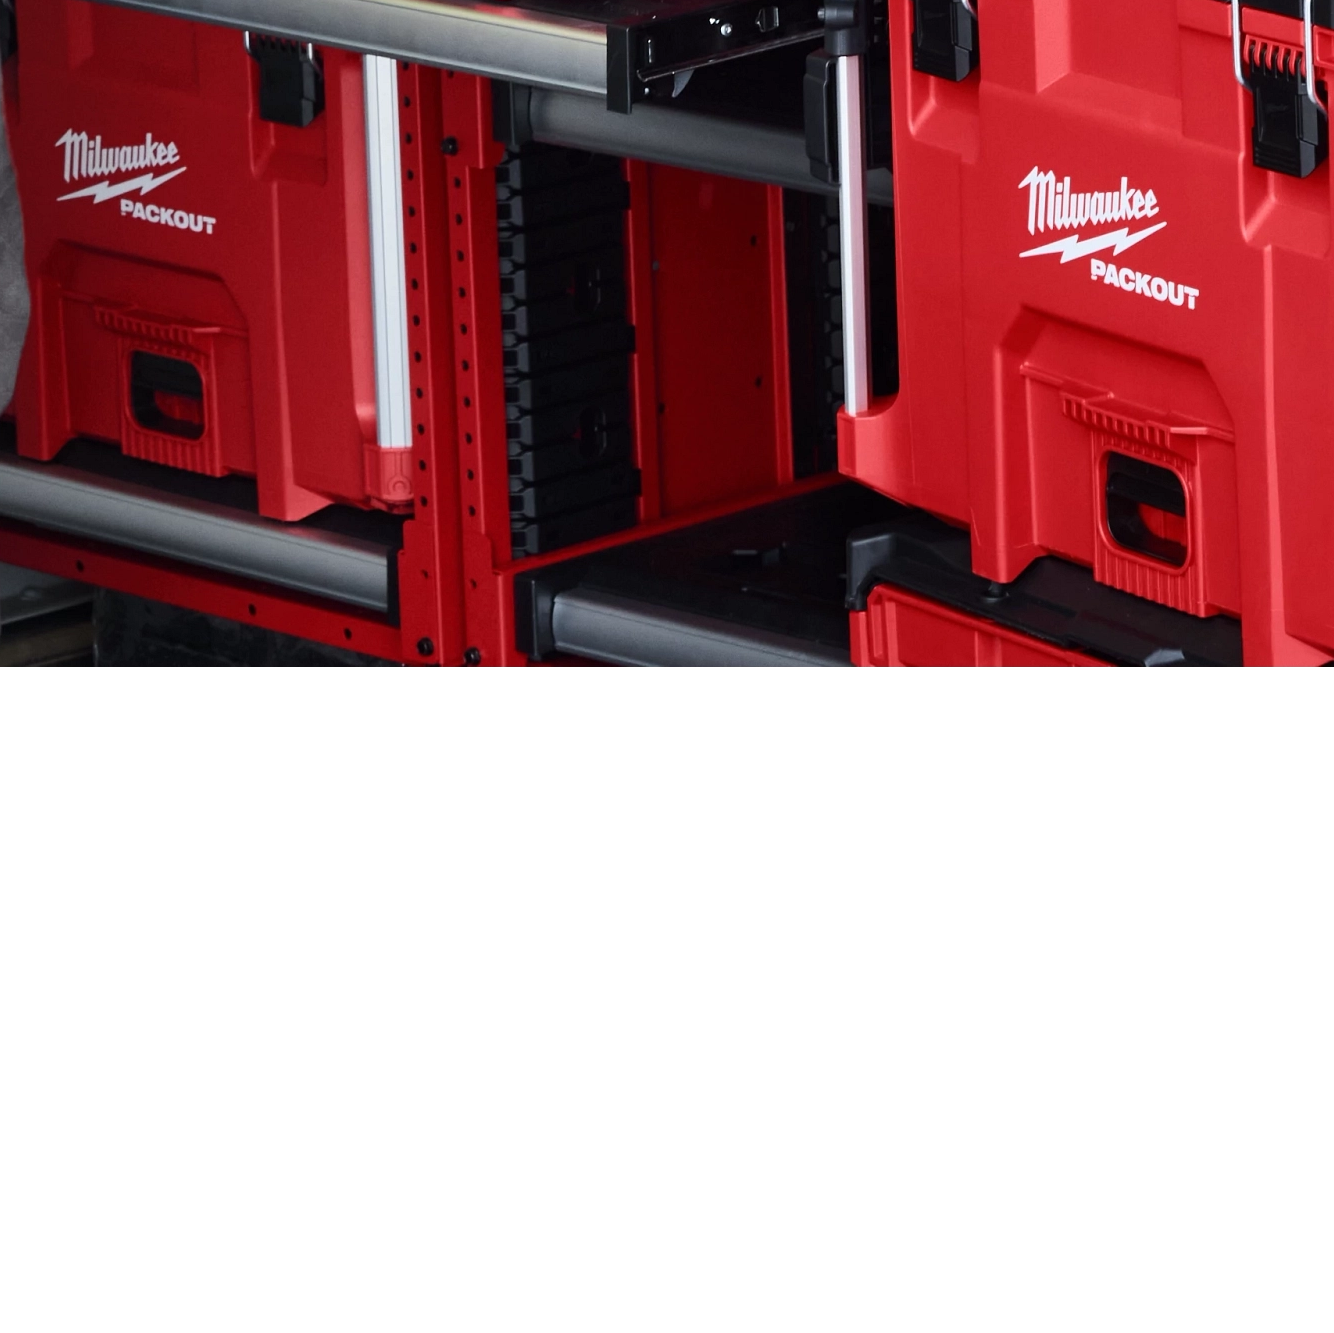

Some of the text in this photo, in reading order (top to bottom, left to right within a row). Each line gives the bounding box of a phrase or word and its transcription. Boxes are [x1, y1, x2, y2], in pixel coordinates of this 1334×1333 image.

[54, 128, 181, 183] Milwaukee
[120, 198, 217, 235] PACKOUT
[1017, 165, 1160, 236] Milwaukee
[1089, 258, 1200, 310] PACKOUT
